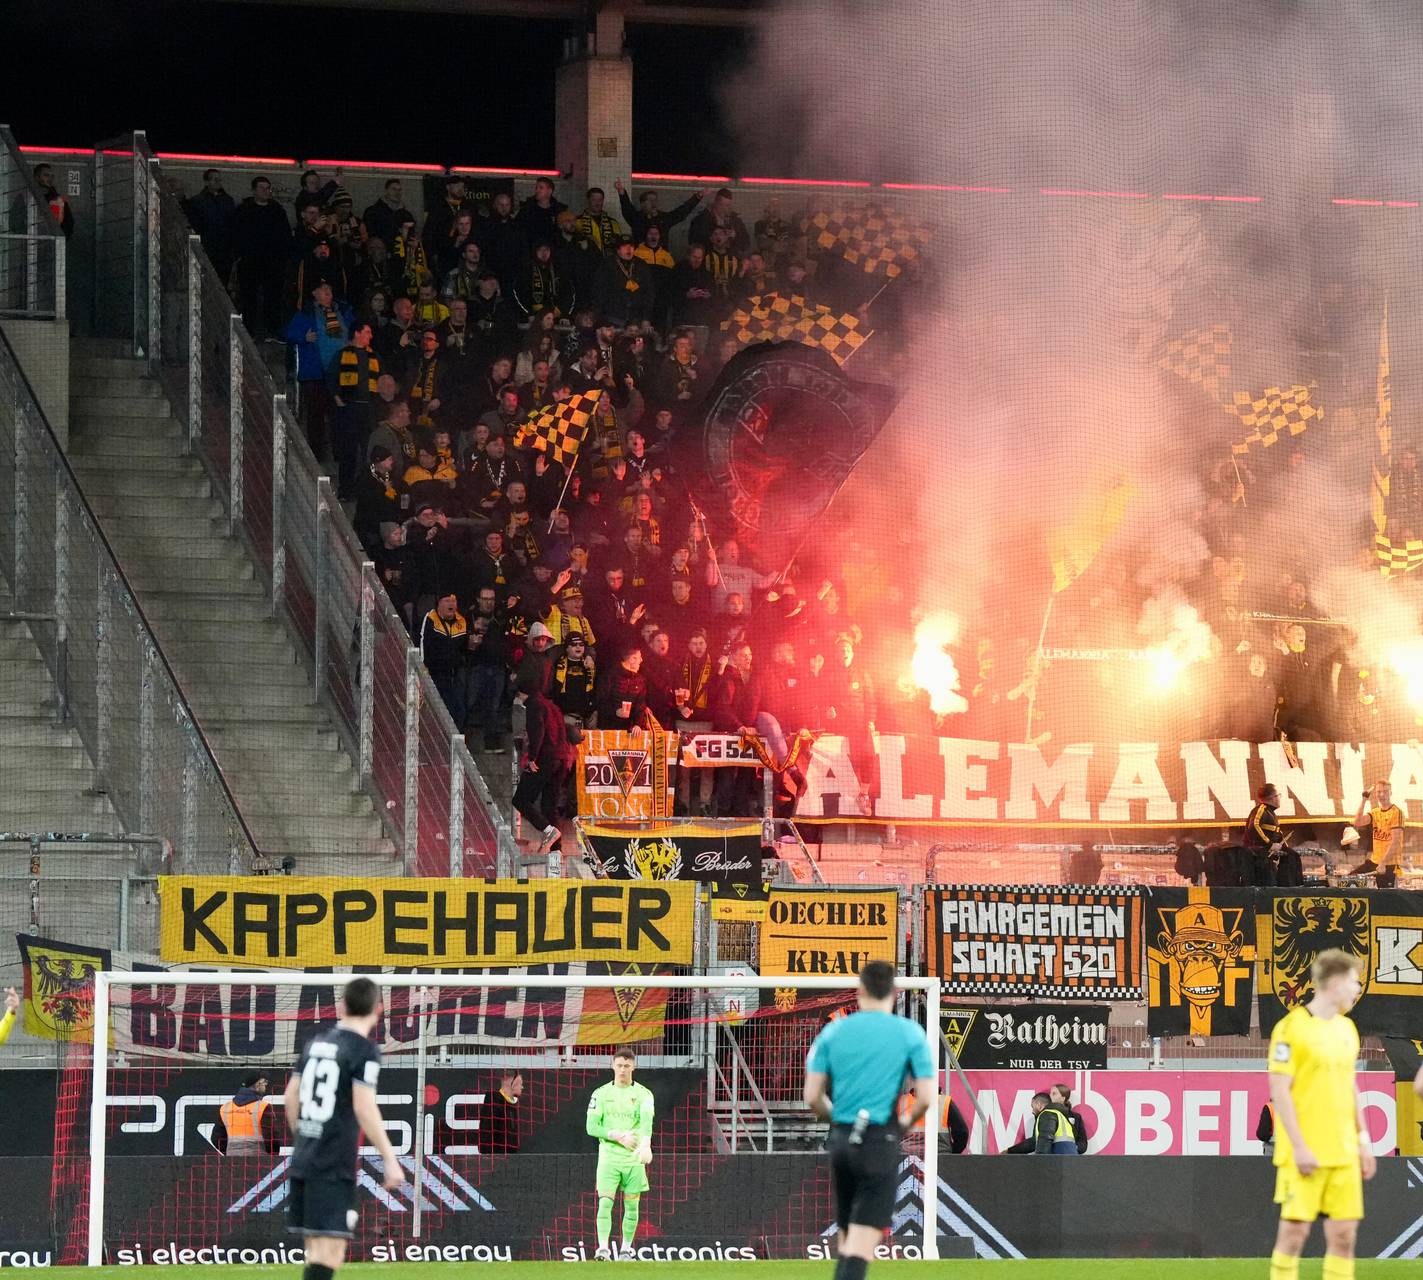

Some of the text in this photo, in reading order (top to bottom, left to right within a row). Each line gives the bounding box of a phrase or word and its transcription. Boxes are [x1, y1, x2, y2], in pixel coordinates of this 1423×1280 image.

[695, 740, 722, 758] FG
[182, 879, 671, 957] KAPPEHÄUER
[769, 900, 888, 926] OECHER
[953, 941, 1116, 978] SCHAFT 520
[131, 962, 277, 1056] BAD
[984, 1012, 1108, 1050] Ratheim
[1010, 1059, 1090, 1070] NUR DER TSV
[298, 1057, 341, 1123] 43
[118, 1242, 306, 1266] si electronic
[371, 1239, 397, 1263] si
[561, 1240, 586, 1262] si
[806, 1239, 831, 1262] si
